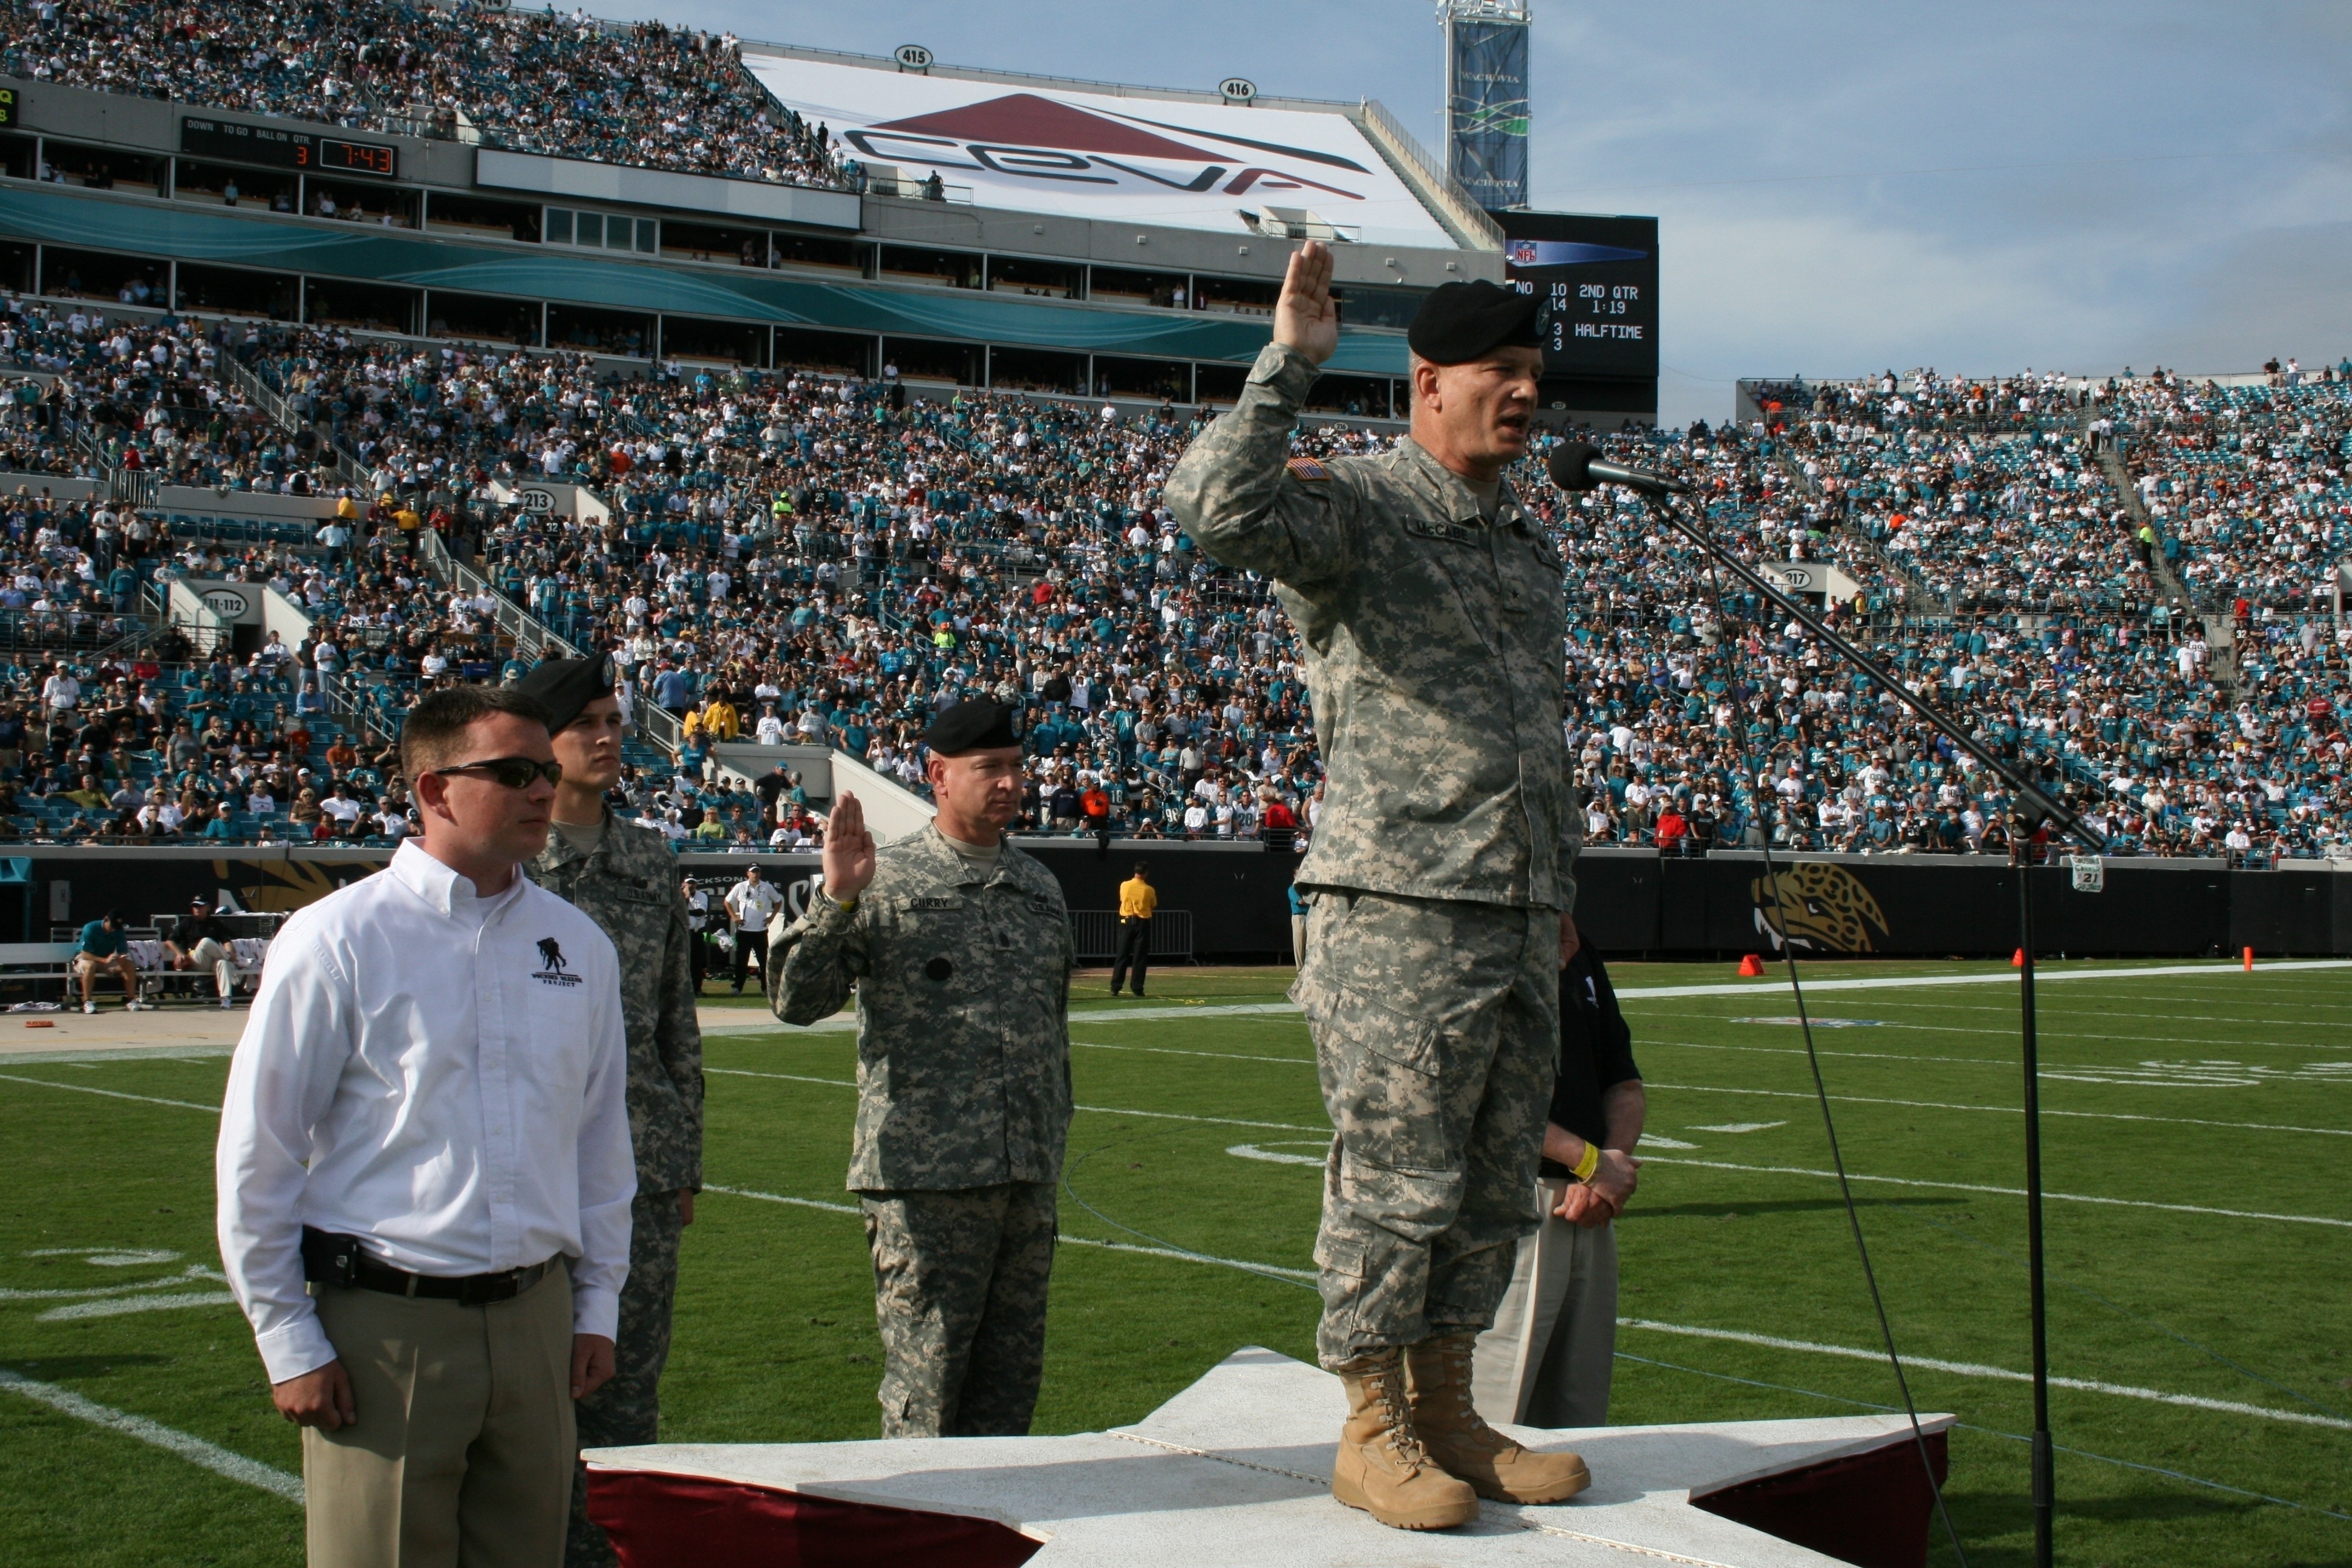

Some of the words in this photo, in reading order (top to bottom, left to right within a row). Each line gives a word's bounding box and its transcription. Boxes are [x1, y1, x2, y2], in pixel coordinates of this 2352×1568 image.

[903, 49, 926, 64] 415
[1461, 71, 1520, 83] WACHOVIA
[1227, 83, 1249, 96] 416
[188, 120, 214, 131] DOWN
[223, 124, 234, 134] TO
[237, 125, 248, 136] GO
[256, 129, 275, 140] BALL
[276, 132, 288, 142] ON
[297, 146, 307, 165] 3
[342, 144, 391, 172] 7:43
[843, 128, 1367, 200] CEVA
[1459, 175, 1519, 188] WACHOVIA
[1516, 250, 1535, 261] NFL
[1515, 281, 1534, 295] NO
[1550, 283, 1567, 296] 10
[1579, 284, 1606, 298] 2ND
[1612, 286, 1638, 300] QTR
[1592, 299, 1626, 314] 1:19
[1553, 322, 1562, 336] 3
[1575, 323, 1643, 339] HALFTIME
[1553, 337, 1562, 351] 3
[524, 493, 548, 508] 213
[815, 493, 825, 502] 25
[546, 522, 558, 532] 32
[1416, 520, 1469, 542] McCABE
[692, 578, 702, 588] 27
[1786, 572, 1806, 585] 217
[546, 586, 556, 597] 18
[456, 605, 470, 615] 54
[2236, 630, 2247, 639] 32
[906, 655, 917, 665] 32
[1186, 690, 1196, 699] 32
[1125, 716, 1132, 728] 11
[1246, 728, 1256, 739] 18
[1918, 766, 1924, 776] 9
[1111, 789, 1122, 803] 18
[1165, 808, 1178, 823] 98
[1238, 812, 1253, 827] 28
[910, 898, 949, 908] CURRY
